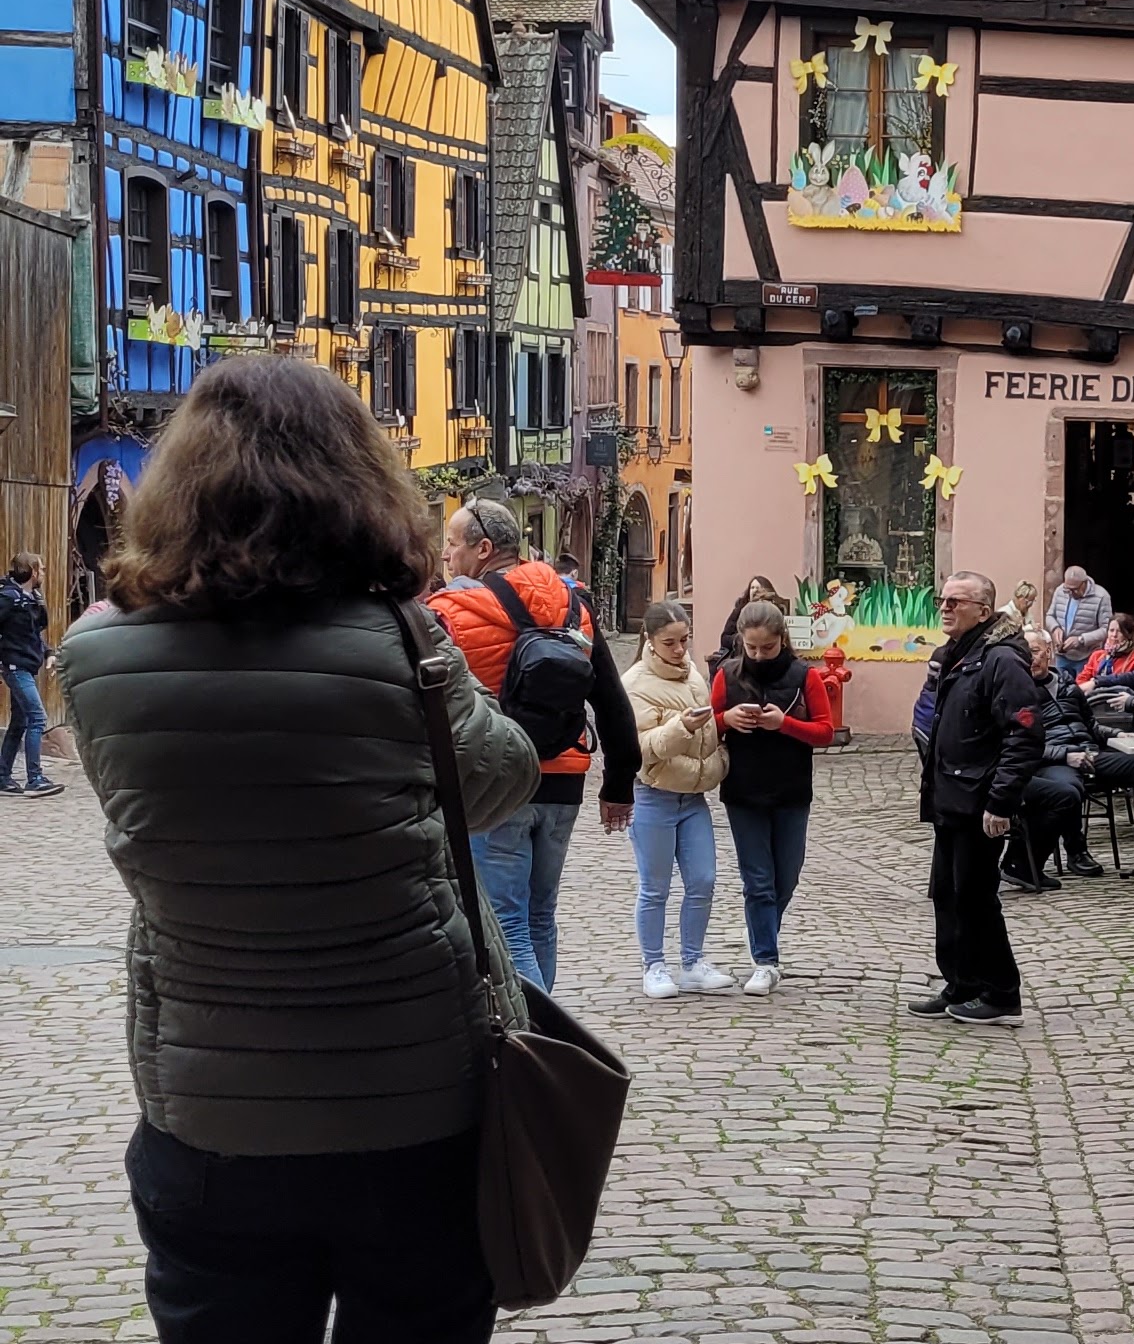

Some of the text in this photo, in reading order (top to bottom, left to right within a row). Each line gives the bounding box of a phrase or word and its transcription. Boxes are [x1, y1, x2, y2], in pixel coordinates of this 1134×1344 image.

[780, 285, 800, 295] RUE
[769, 294, 812, 305] DU CERF
[984, 370, 1102, 403] FEERIE
